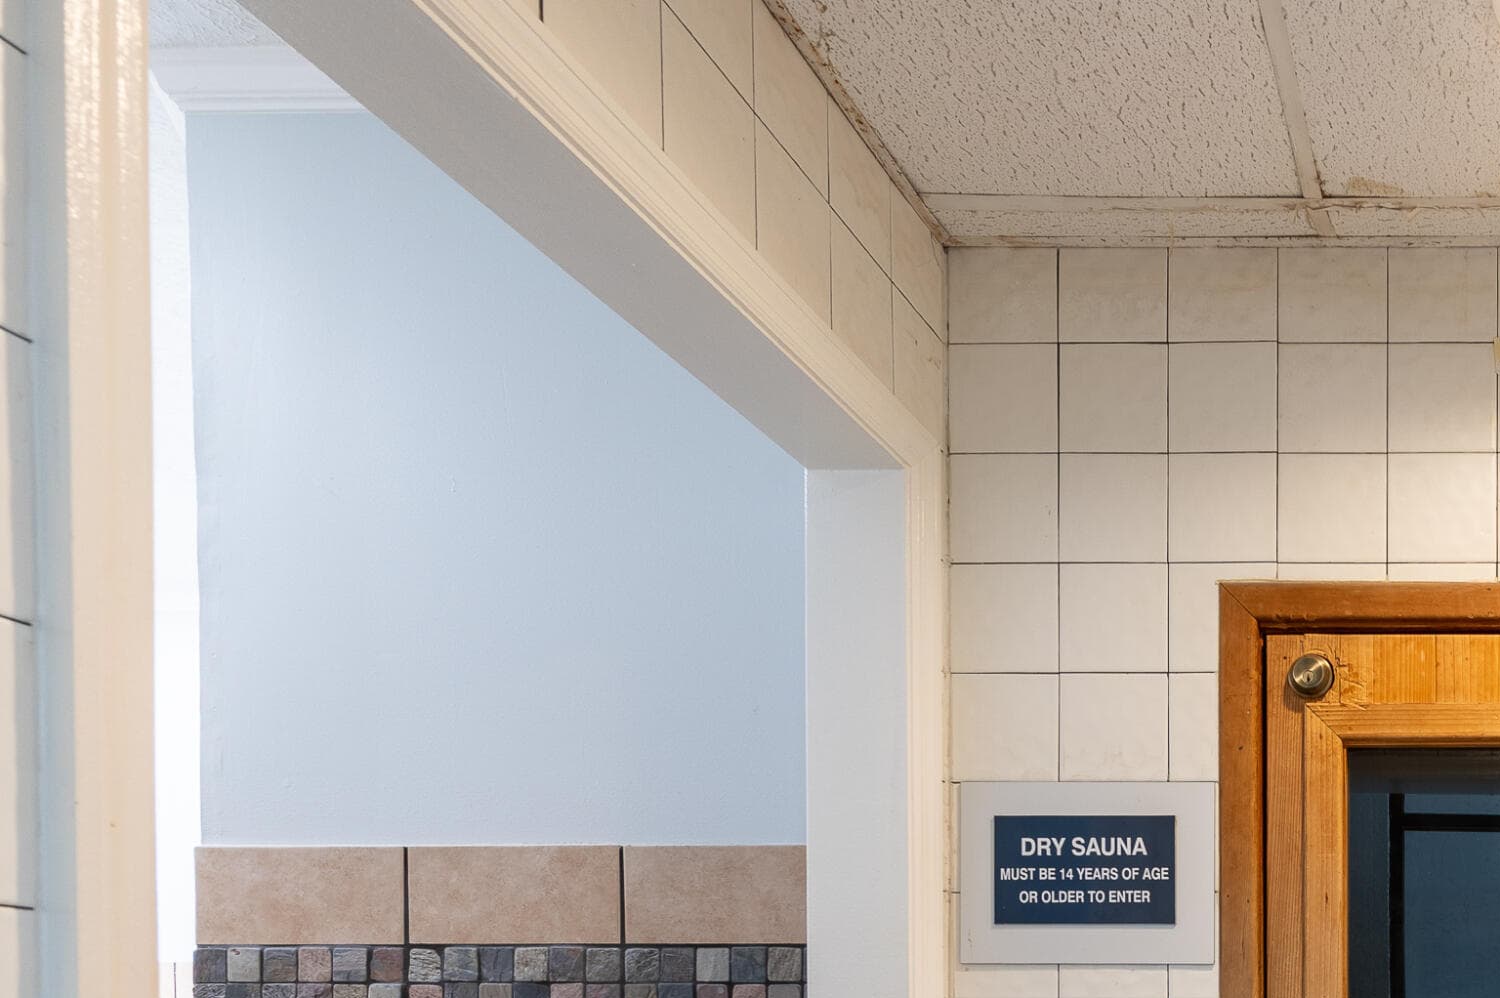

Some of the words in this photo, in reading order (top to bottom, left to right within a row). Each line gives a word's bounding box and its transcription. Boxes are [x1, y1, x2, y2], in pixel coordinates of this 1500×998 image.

[1020, 837, 1066, 856] DRY
[1071, 836, 1148, 856] SAUNA
[1000, 867, 1035, 881] MUST
[1039, 867, 1057, 880] BE
[1059, 867, 1074, 880] 14
[1077, 867, 1118, 881] YEARS
[1121, 867, 1139, 881] OF
[1142, 867, 1170, 880] AGE
[1019, 890, 1038, 903] OR
[1041, 890, 1085, 903] OLDER
[1087, 890, 1106, 903] TO
[1108, 890, 1151, 903] ENTER
